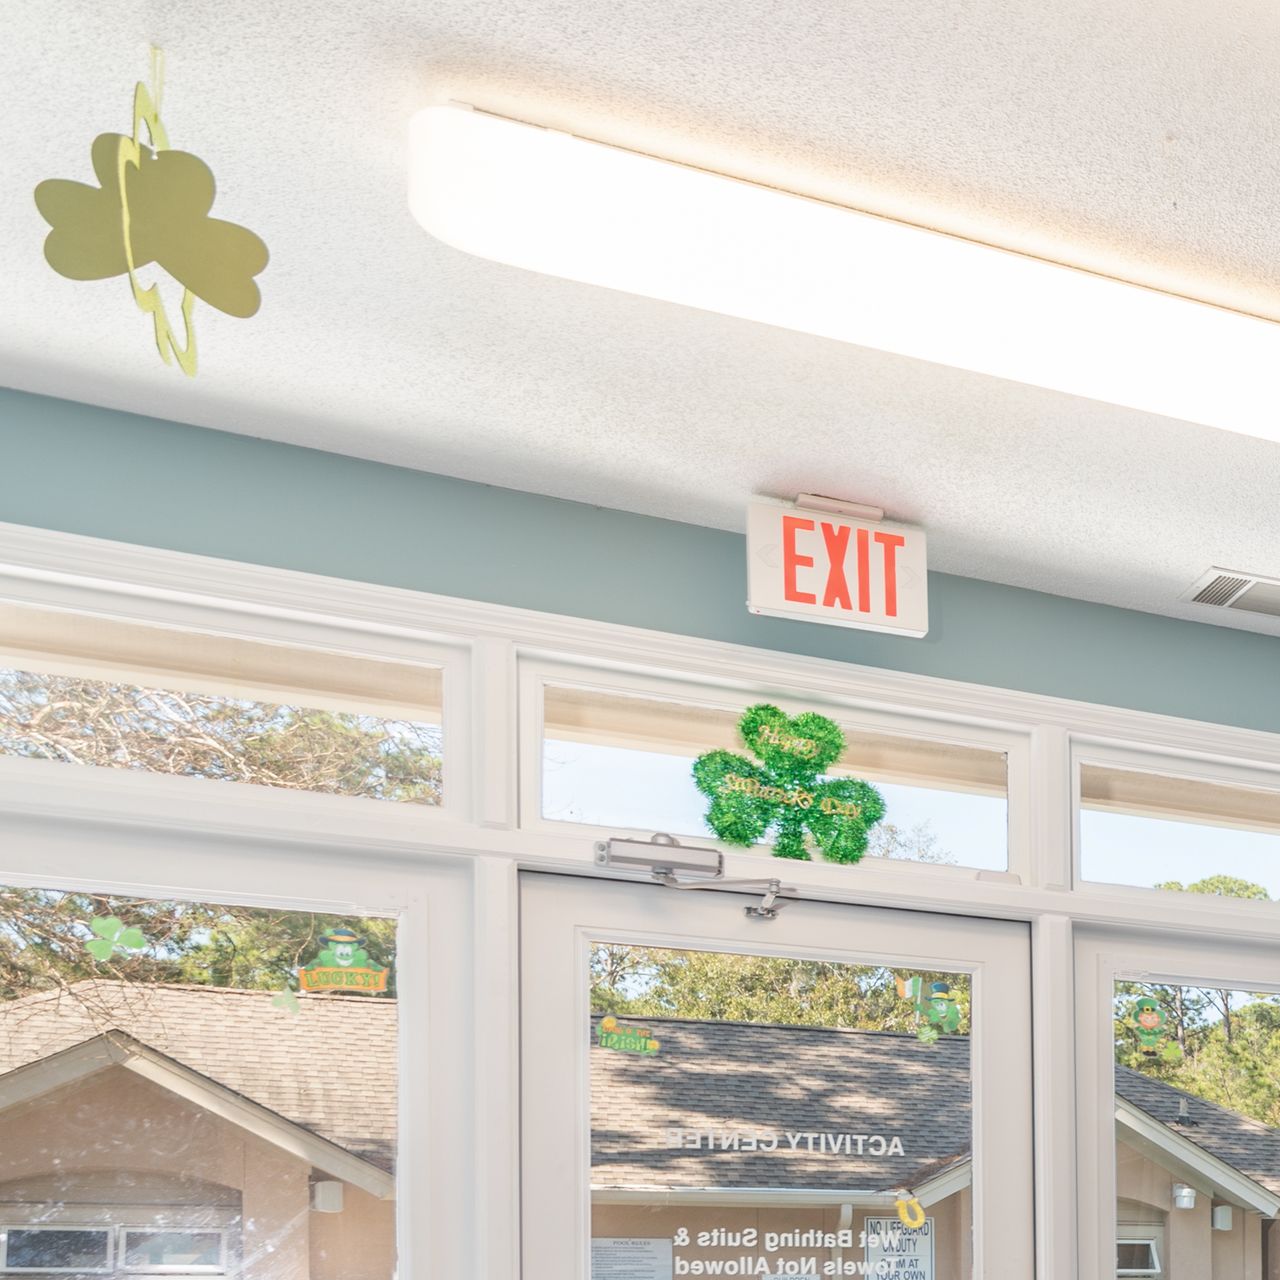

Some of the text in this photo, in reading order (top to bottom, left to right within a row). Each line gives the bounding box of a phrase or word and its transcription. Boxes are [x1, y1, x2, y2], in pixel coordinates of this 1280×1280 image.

[783, 516, 905, 617] EXIT
[820, 797, 861, 819] Day
[304, 971, 379, 987] LUCKY!
[870, 1221, 882, 1235] NO
[909, 1258, 919, 1268] AT
[904, 1270, 925, 1280] OWN
